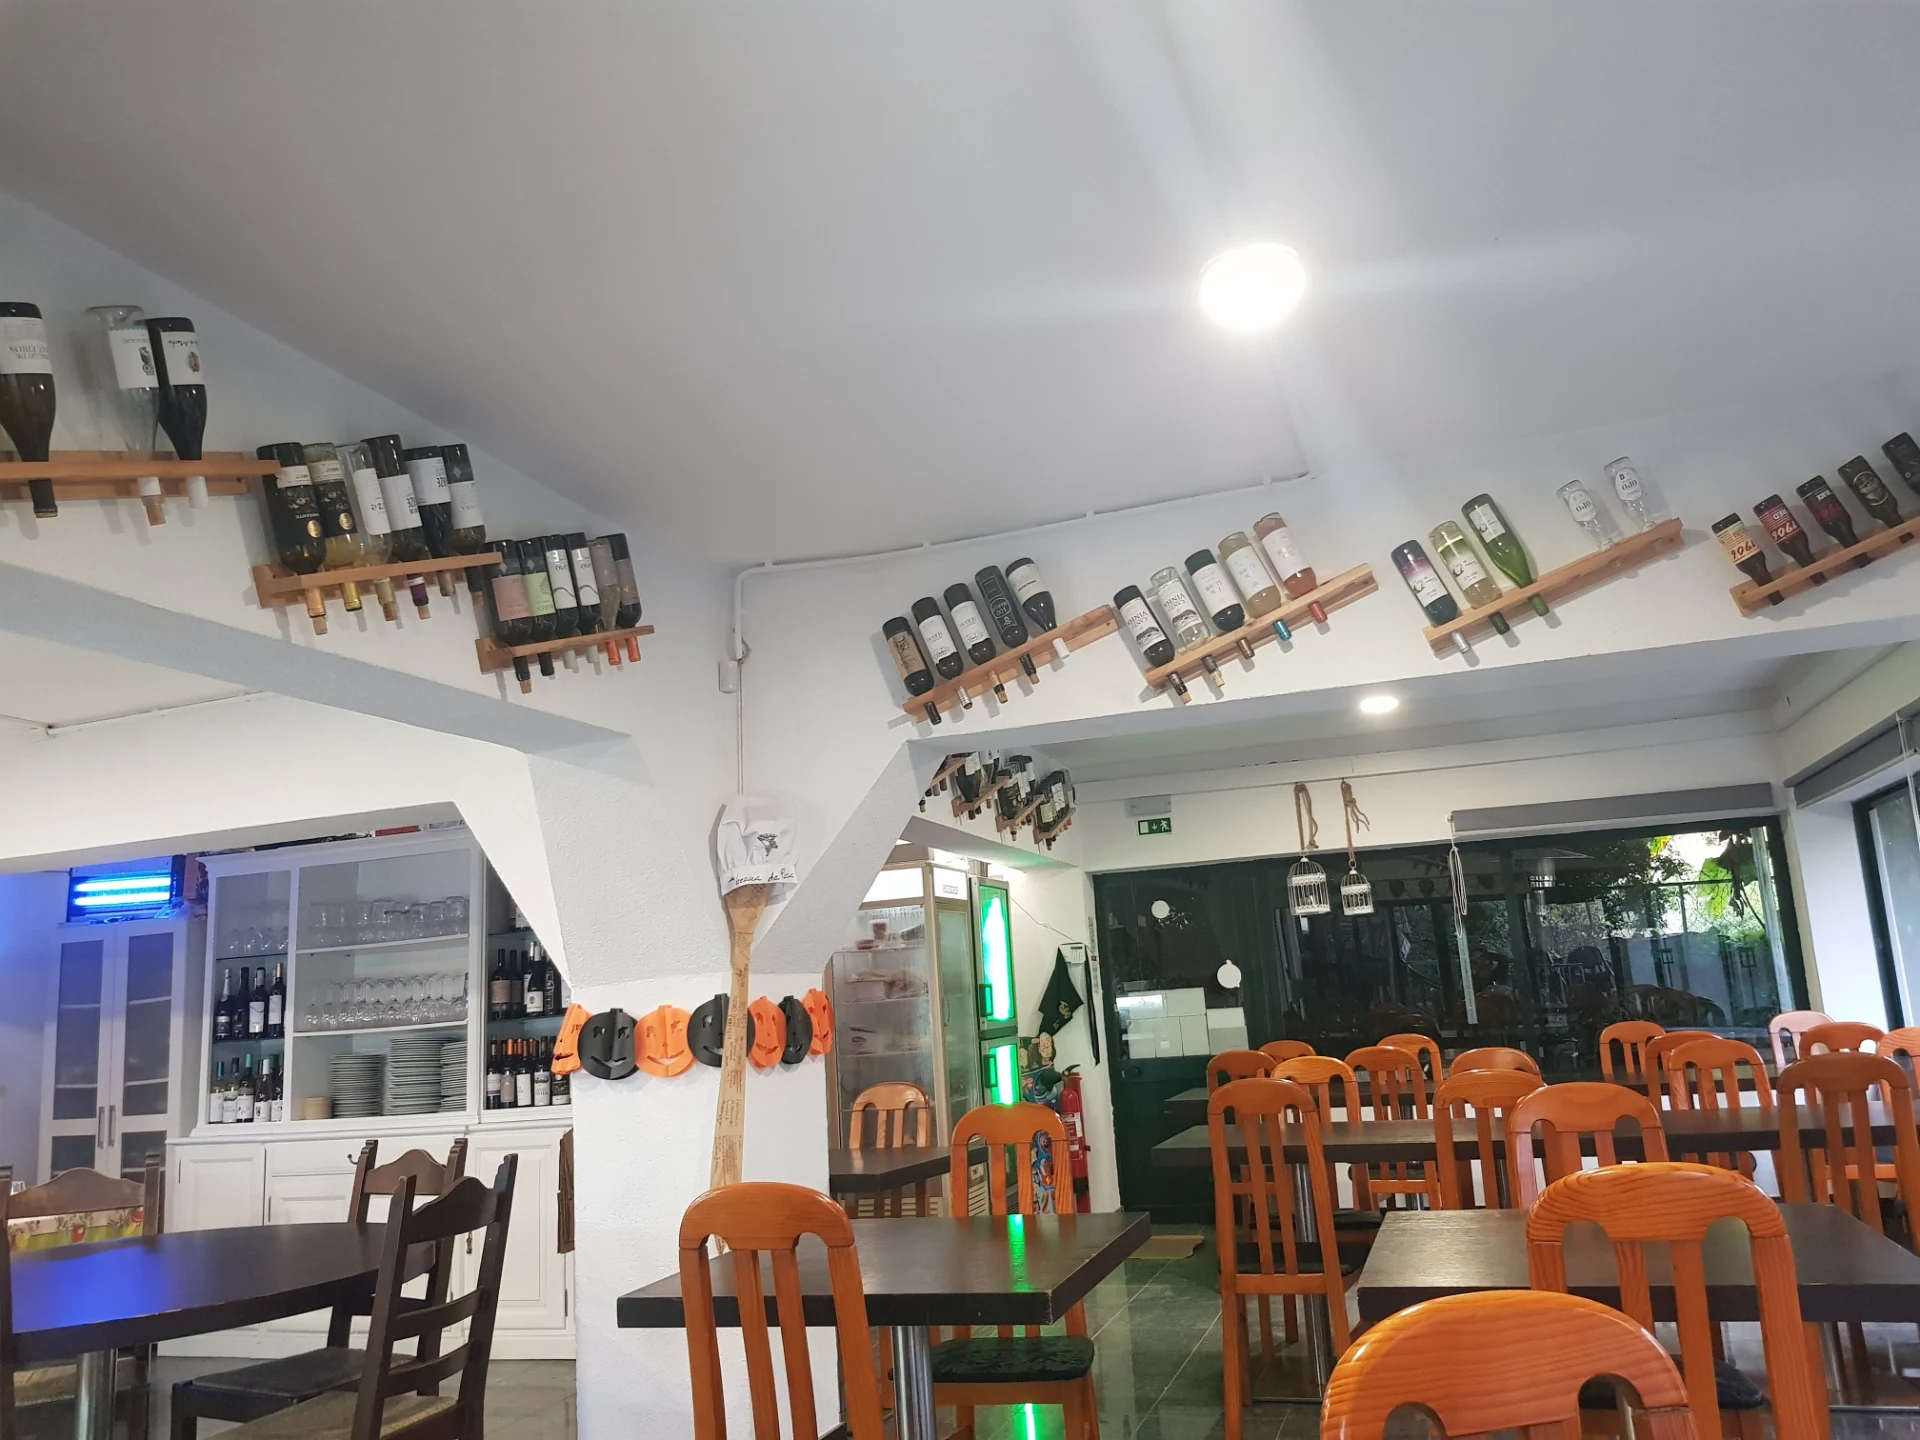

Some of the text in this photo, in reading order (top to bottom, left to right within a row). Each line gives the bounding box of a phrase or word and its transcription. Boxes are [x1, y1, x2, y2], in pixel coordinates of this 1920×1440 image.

[1773, 509, 1788, 520] RED
[1772, 521, 1797, 541] 1906
[1731, 539, 1756, 560] 1906
